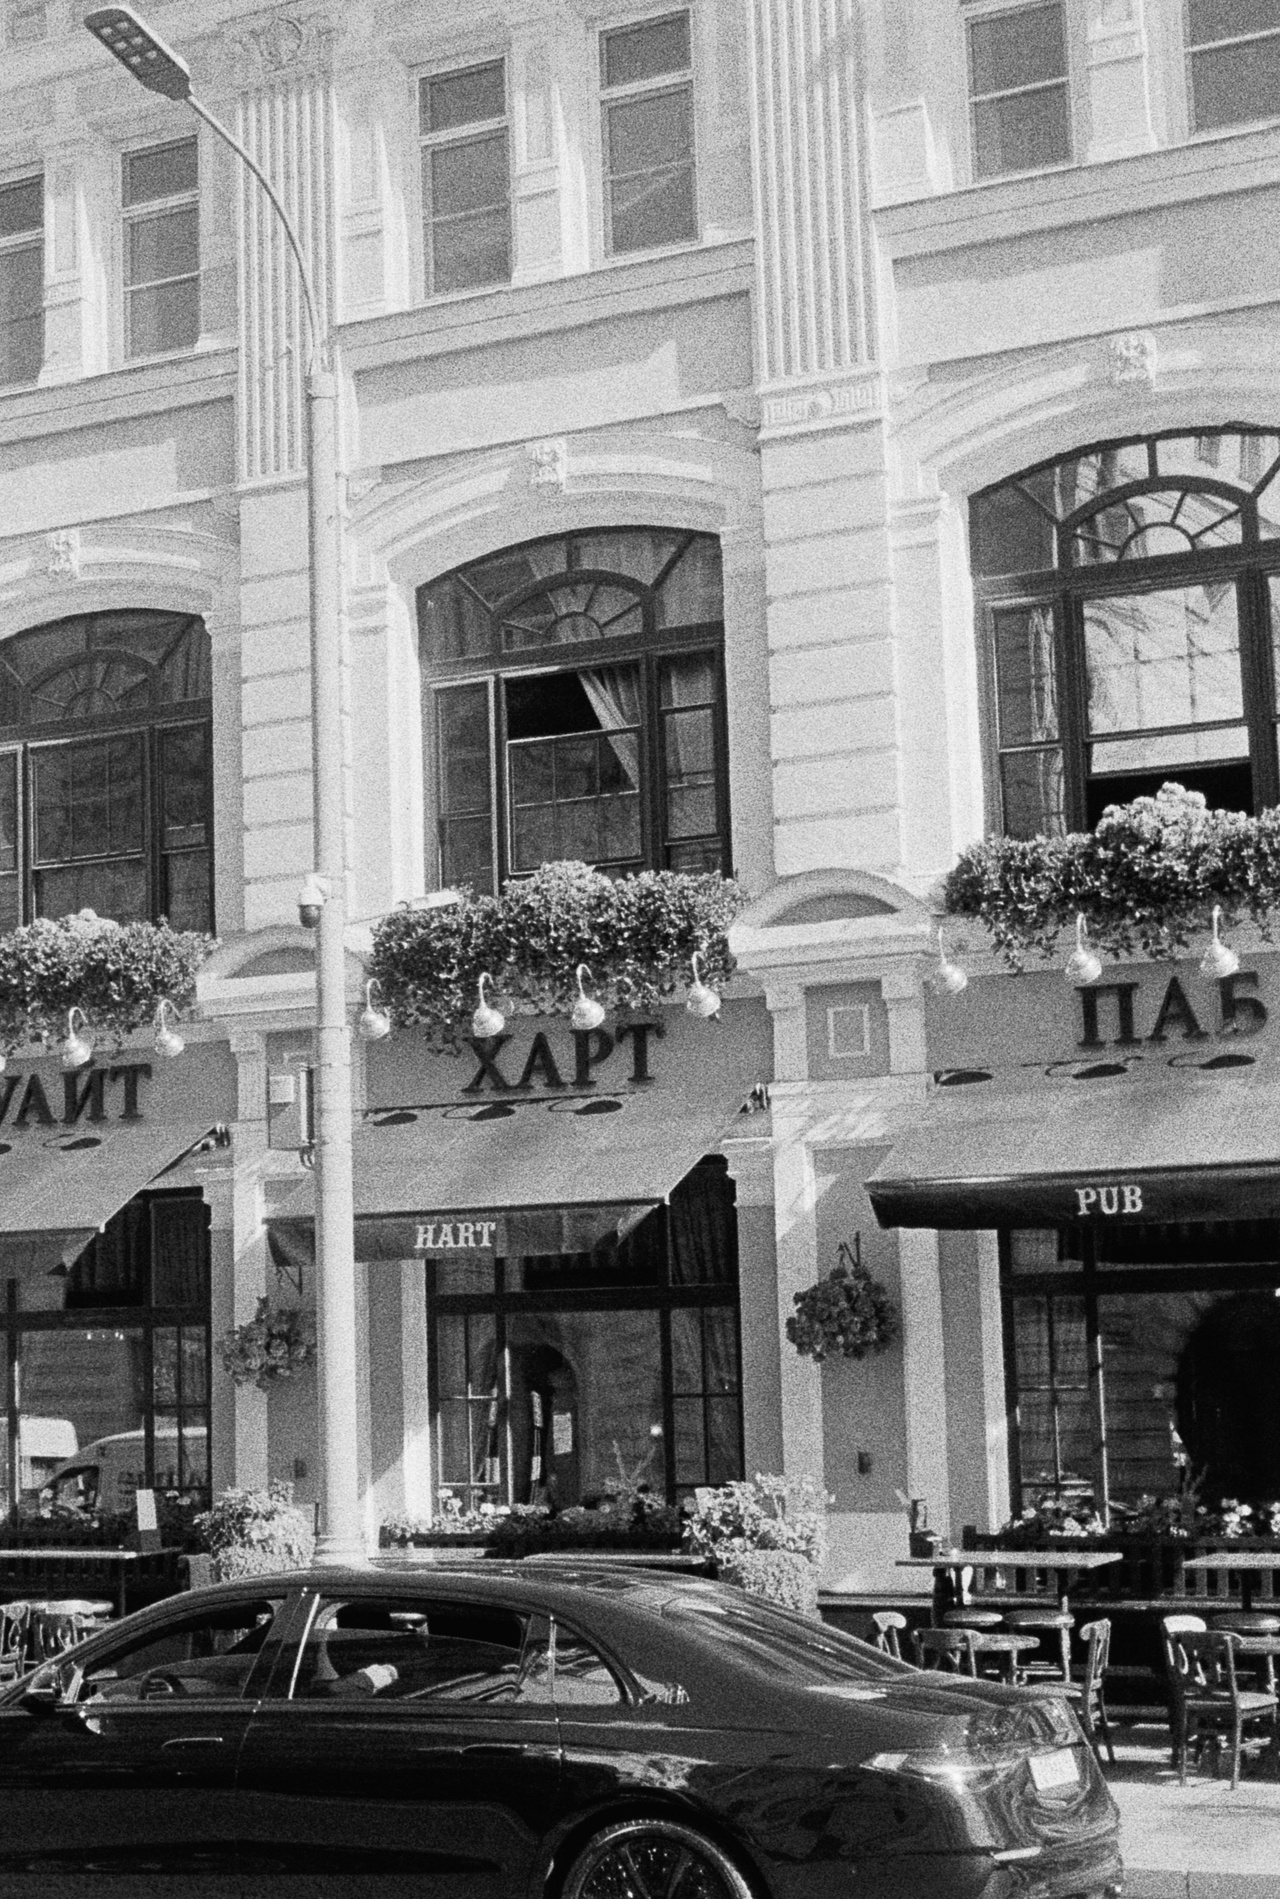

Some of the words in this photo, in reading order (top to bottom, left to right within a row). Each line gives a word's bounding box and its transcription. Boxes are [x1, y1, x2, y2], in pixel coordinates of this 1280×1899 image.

[1074, 970, 1268, 1046] ПАБ
[461, 1022, 666, 1092] ХАРТ
[1074, 1185, 1143, 1215] PUB
[414, 1221, 496, 1248] HART
